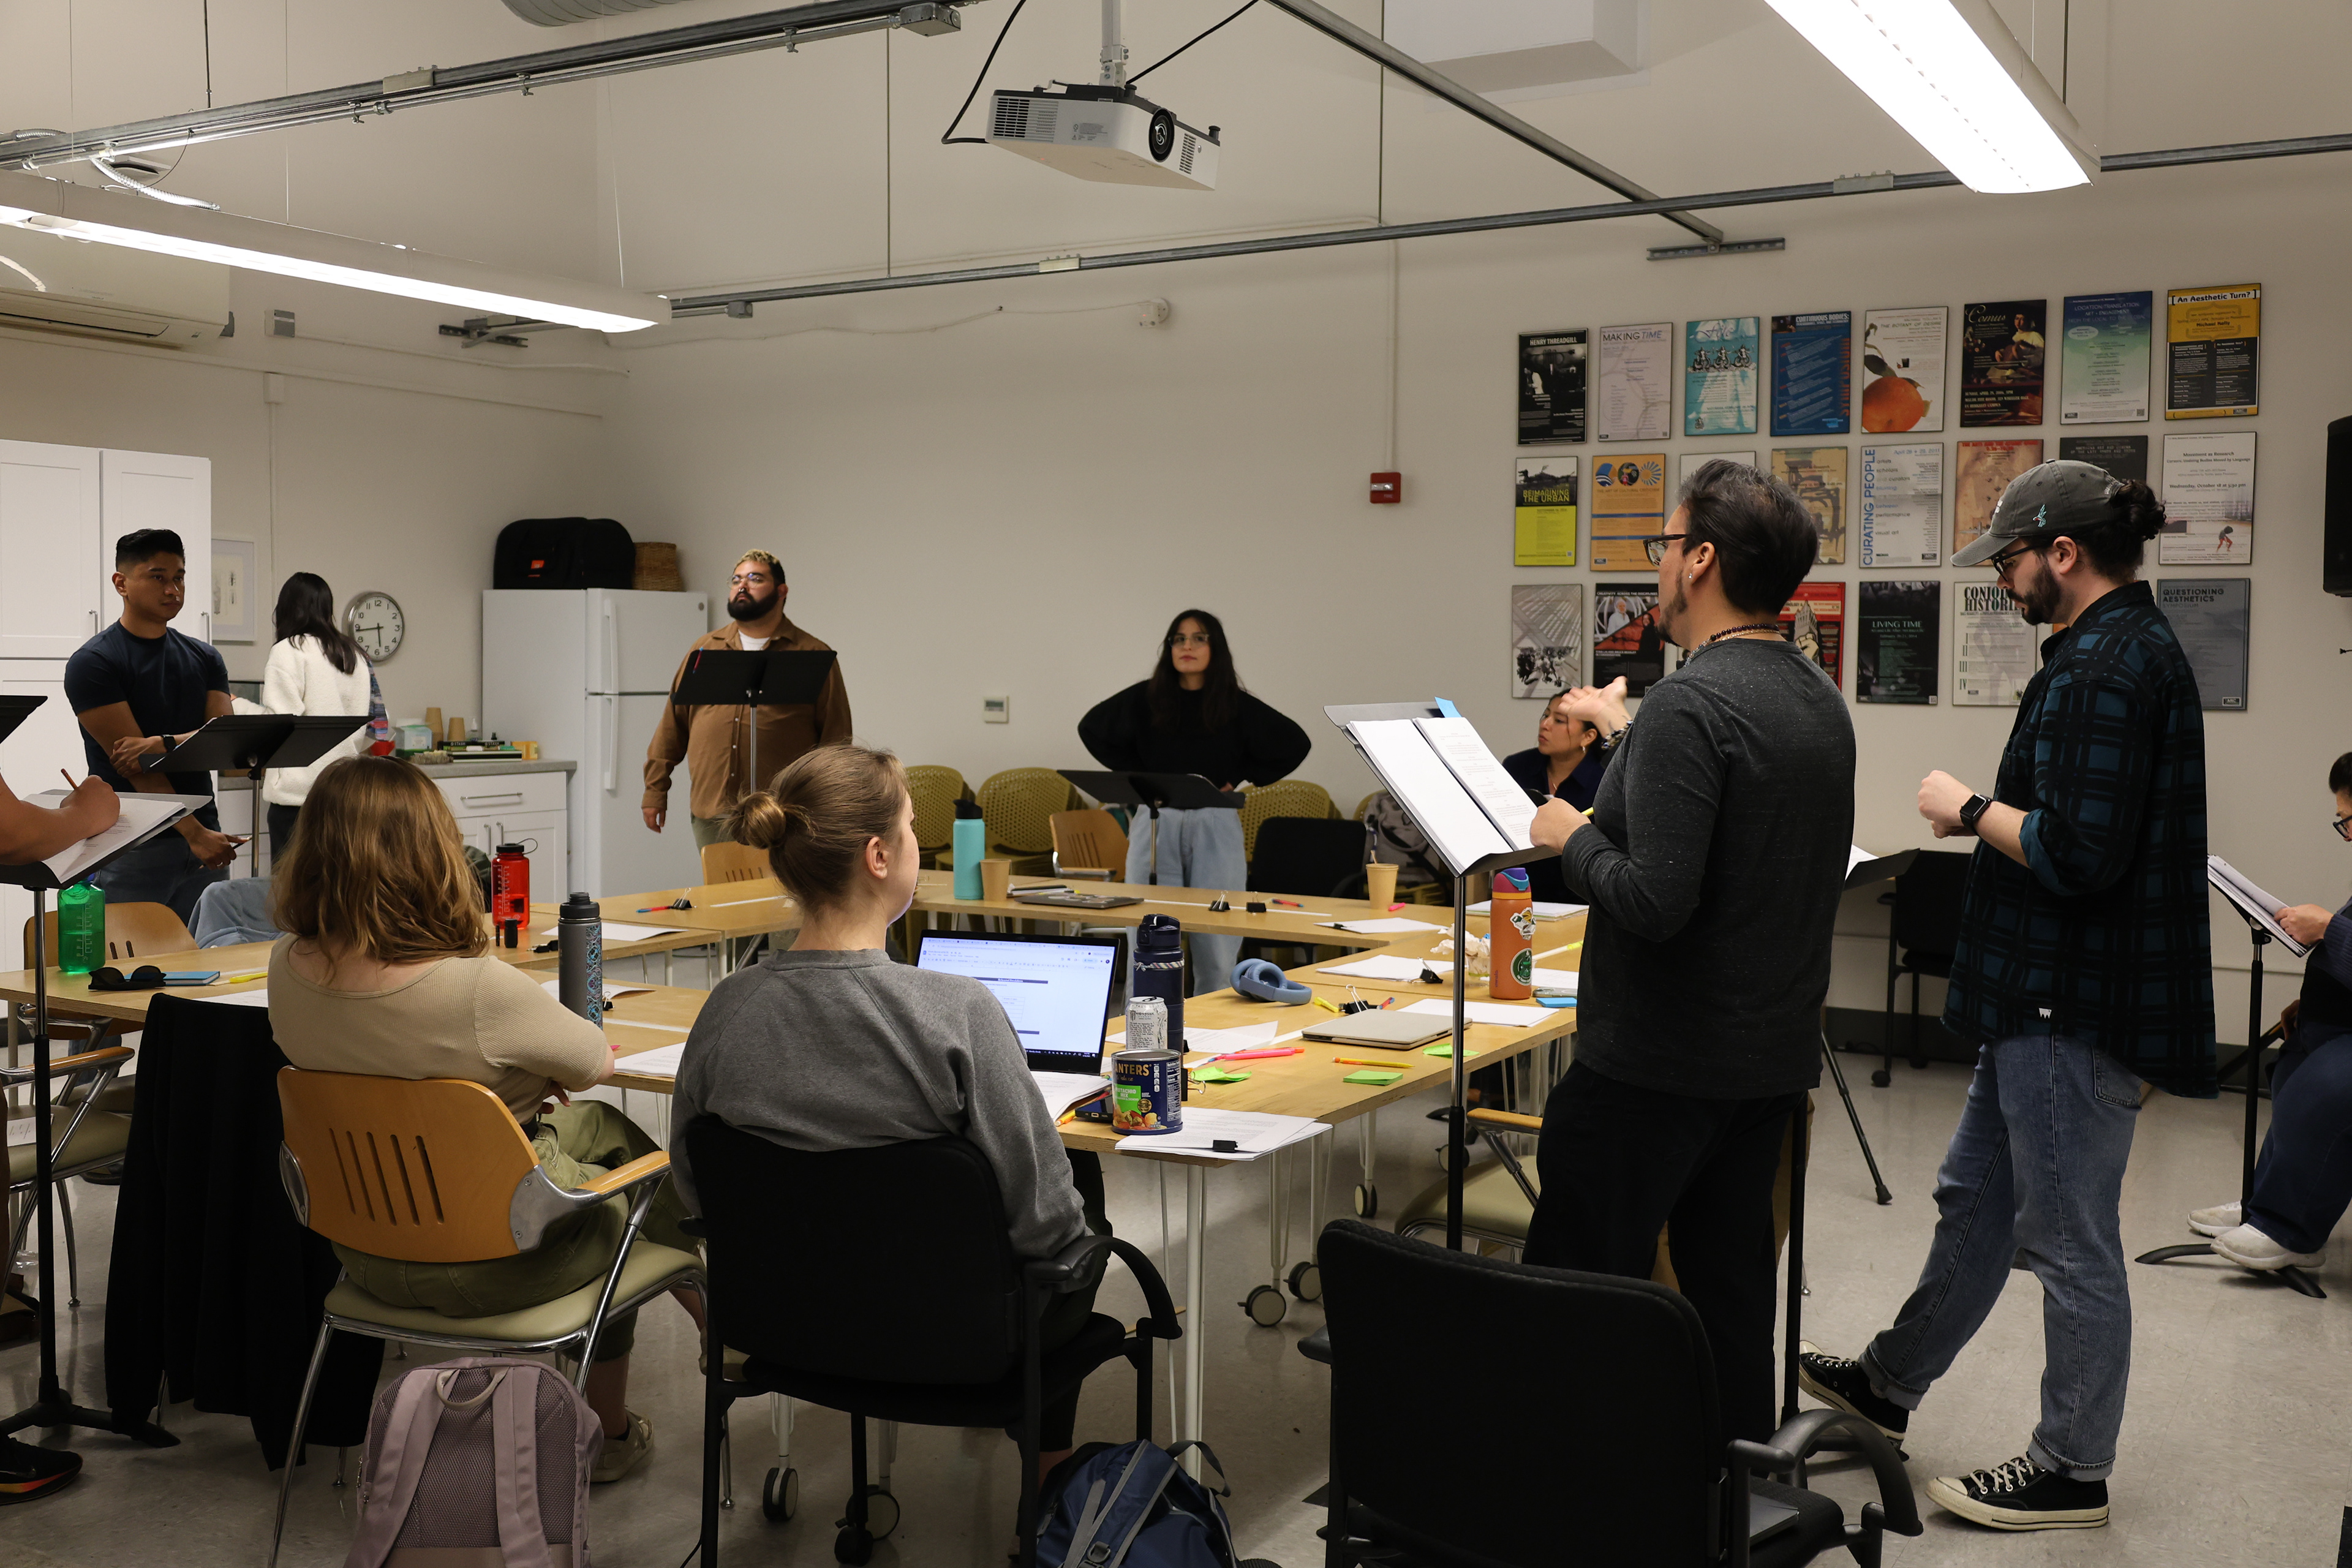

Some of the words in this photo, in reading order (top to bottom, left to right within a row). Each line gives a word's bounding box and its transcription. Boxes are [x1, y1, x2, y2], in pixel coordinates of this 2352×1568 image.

[2190, 293, 2227, 302] Aesthetic
[1965, 304, 2006, 323] Comus
[1602, 332, 1640, 341] MAKING
[1642, 330, 1662, 339] TIME
[1864, 449, 1875, 498] PEOPLE
[1523, 489, 1569, 497] REIMAGINING
[1863, 502, 1874, 565] CURATING
[1960, 679, 1967, 690] IV
